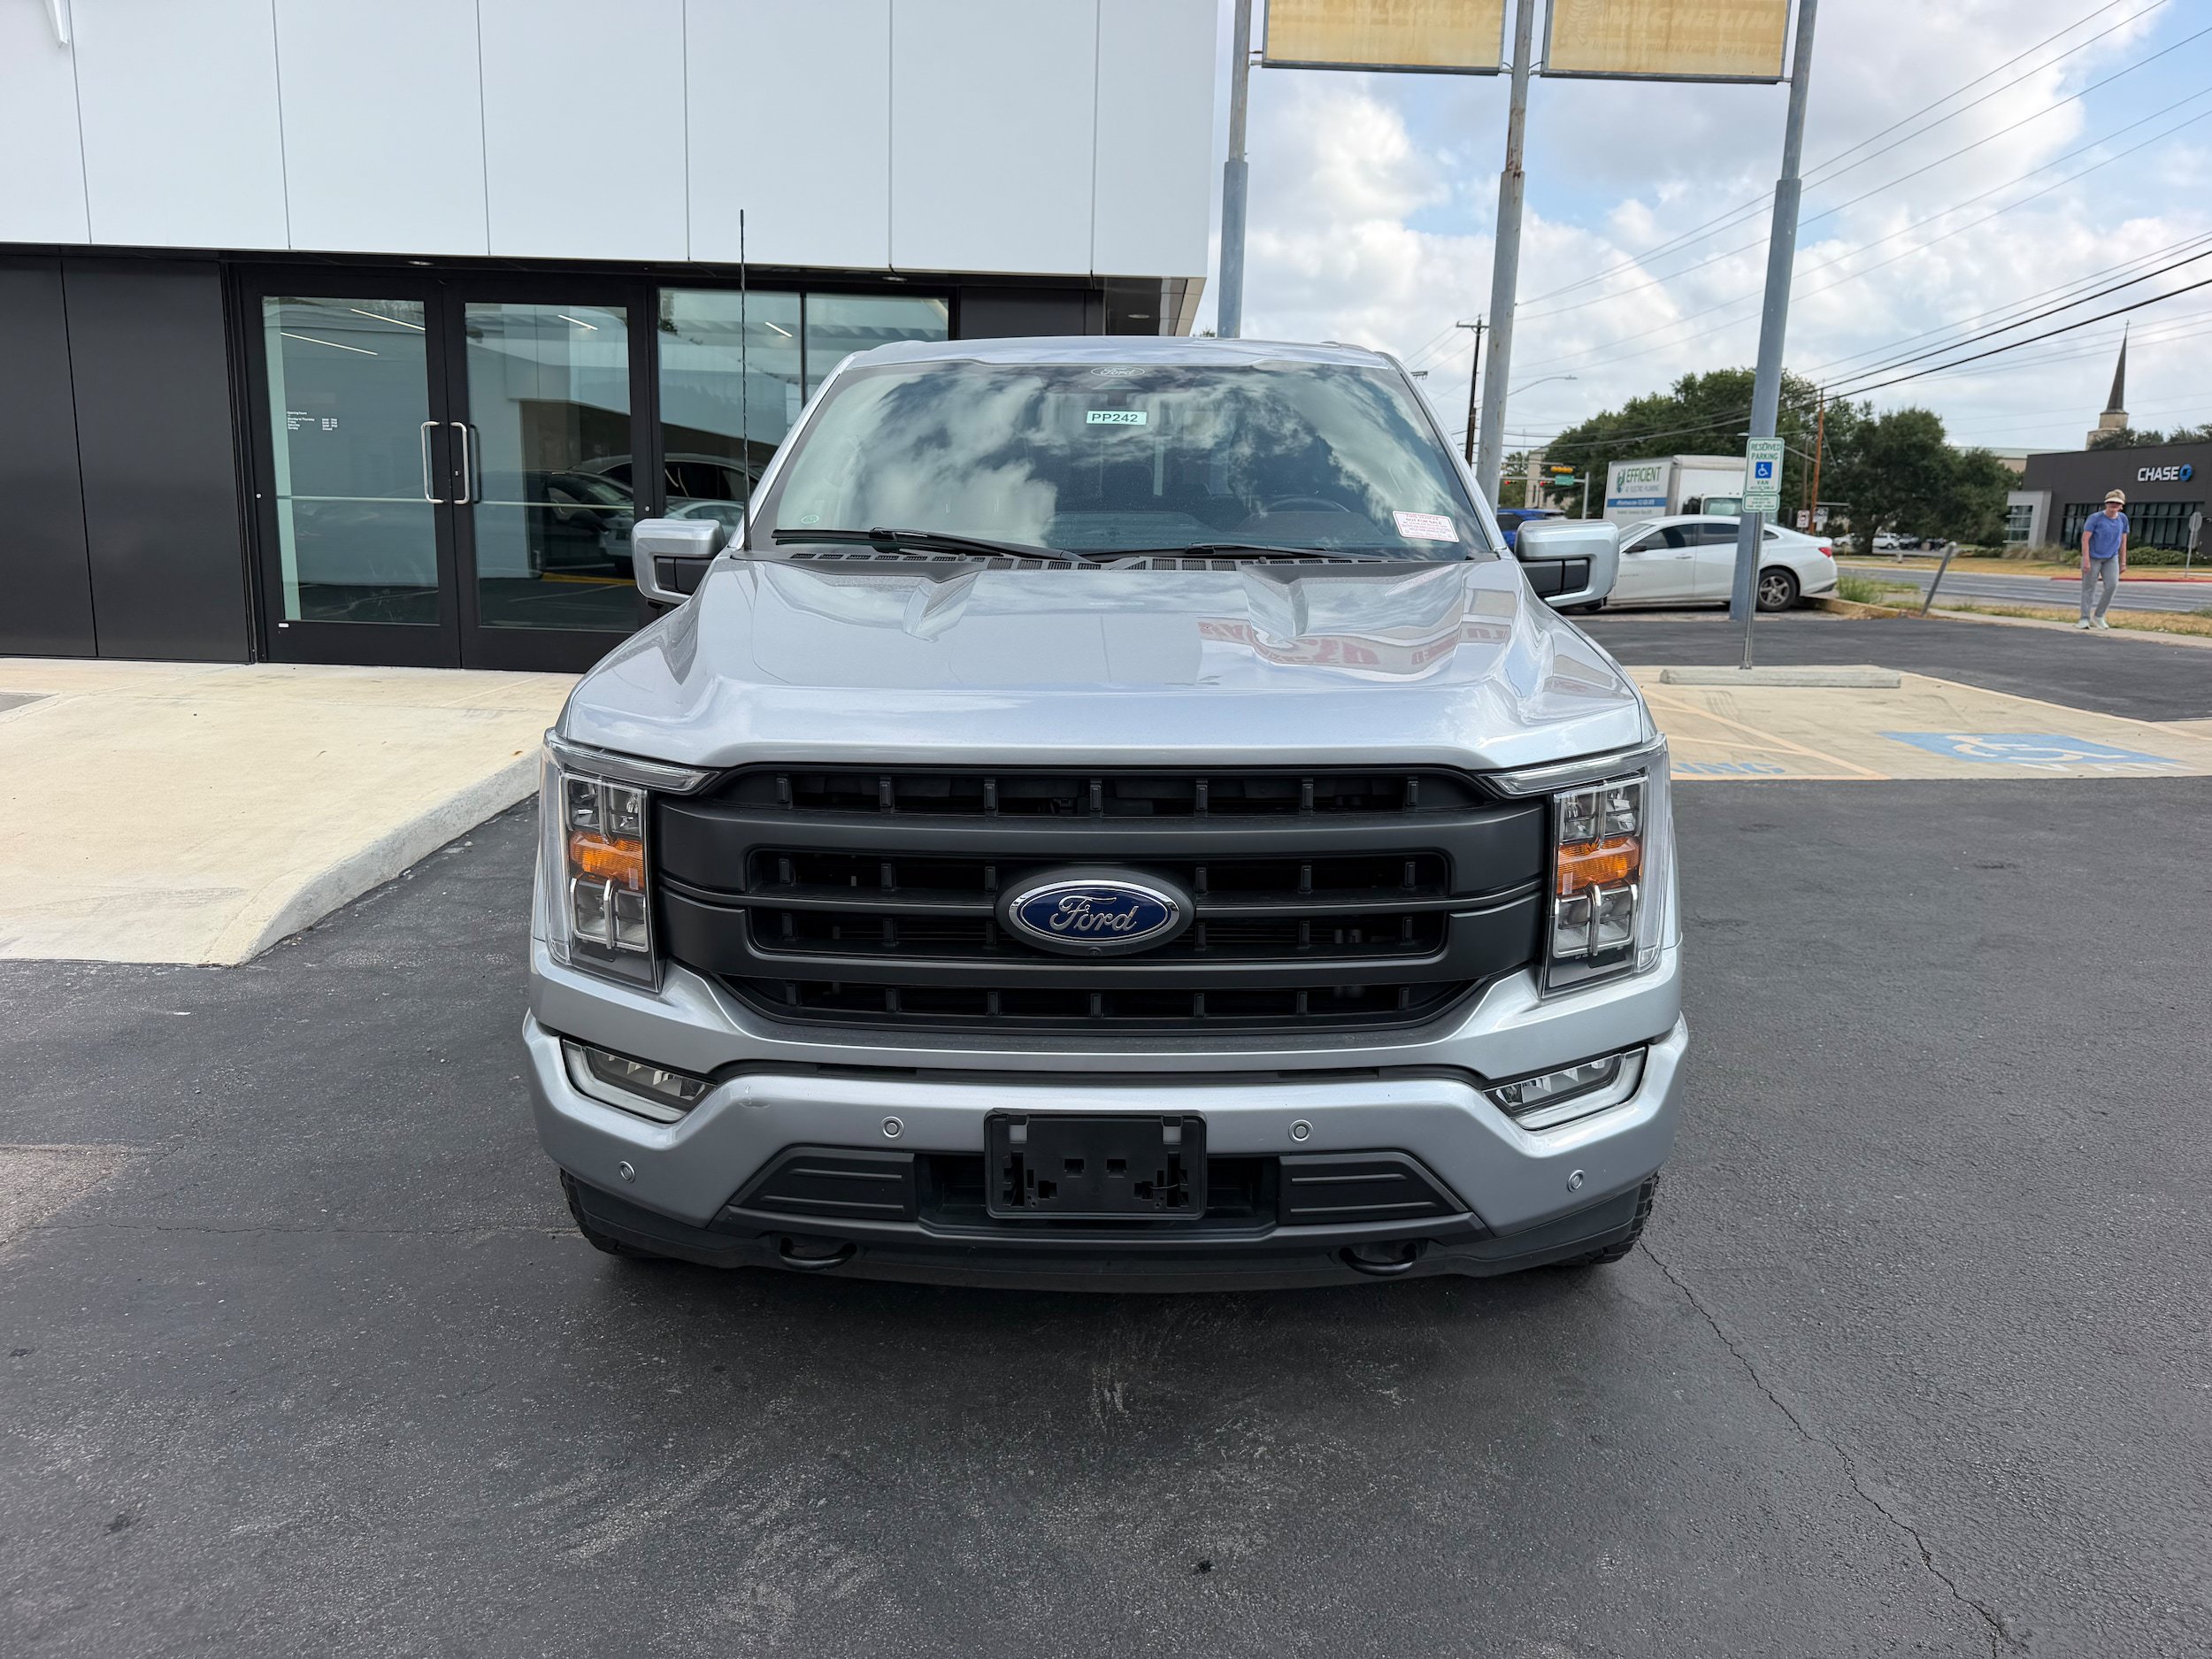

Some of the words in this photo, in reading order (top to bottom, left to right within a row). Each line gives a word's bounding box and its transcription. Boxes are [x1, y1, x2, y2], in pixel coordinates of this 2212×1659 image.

[1092, 413, 1138, 423] PP242
[1626, 466, 1662, 483] EFFICIENT
[2137, 466, 2180, 481] CHASE
[1048, 895, 1140, 932] Ford
